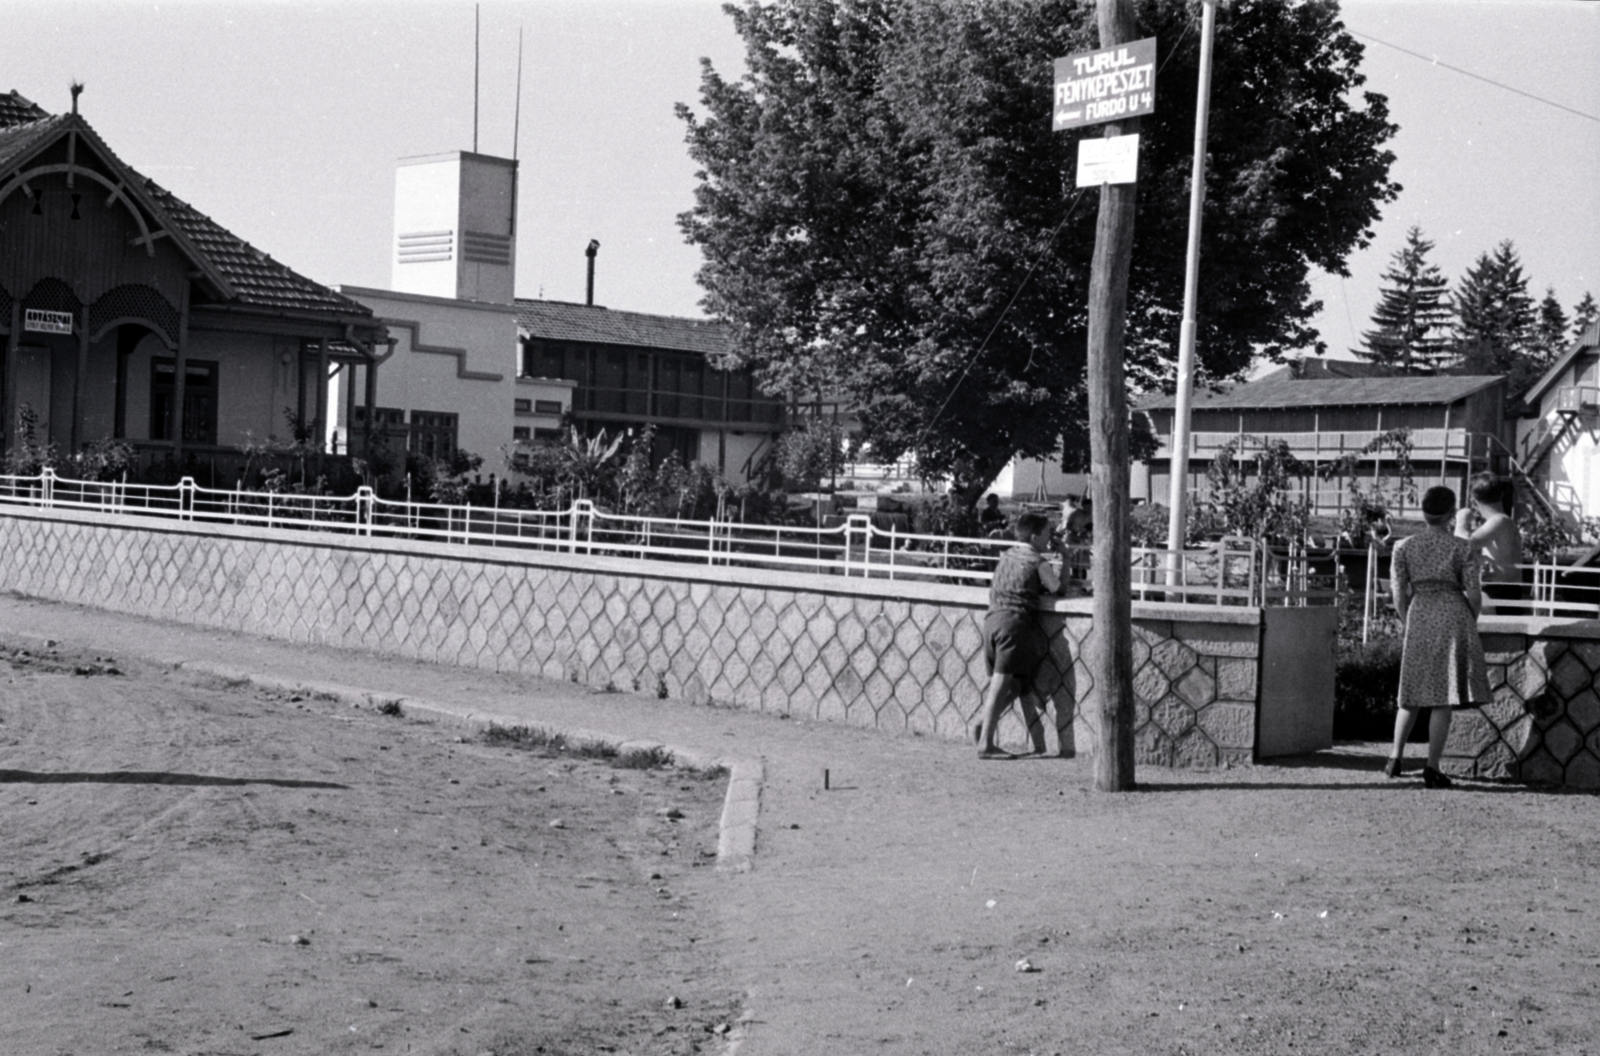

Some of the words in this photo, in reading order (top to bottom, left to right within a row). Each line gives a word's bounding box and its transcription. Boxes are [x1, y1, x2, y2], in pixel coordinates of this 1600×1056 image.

[1073, 48, 1136, 75] TURUL
[1056, 63, 1153, 106] FÉNYKÉPÉSZET
[1129, 93, 1138, 111] U
[1141, 91, 1152, 108] 4
